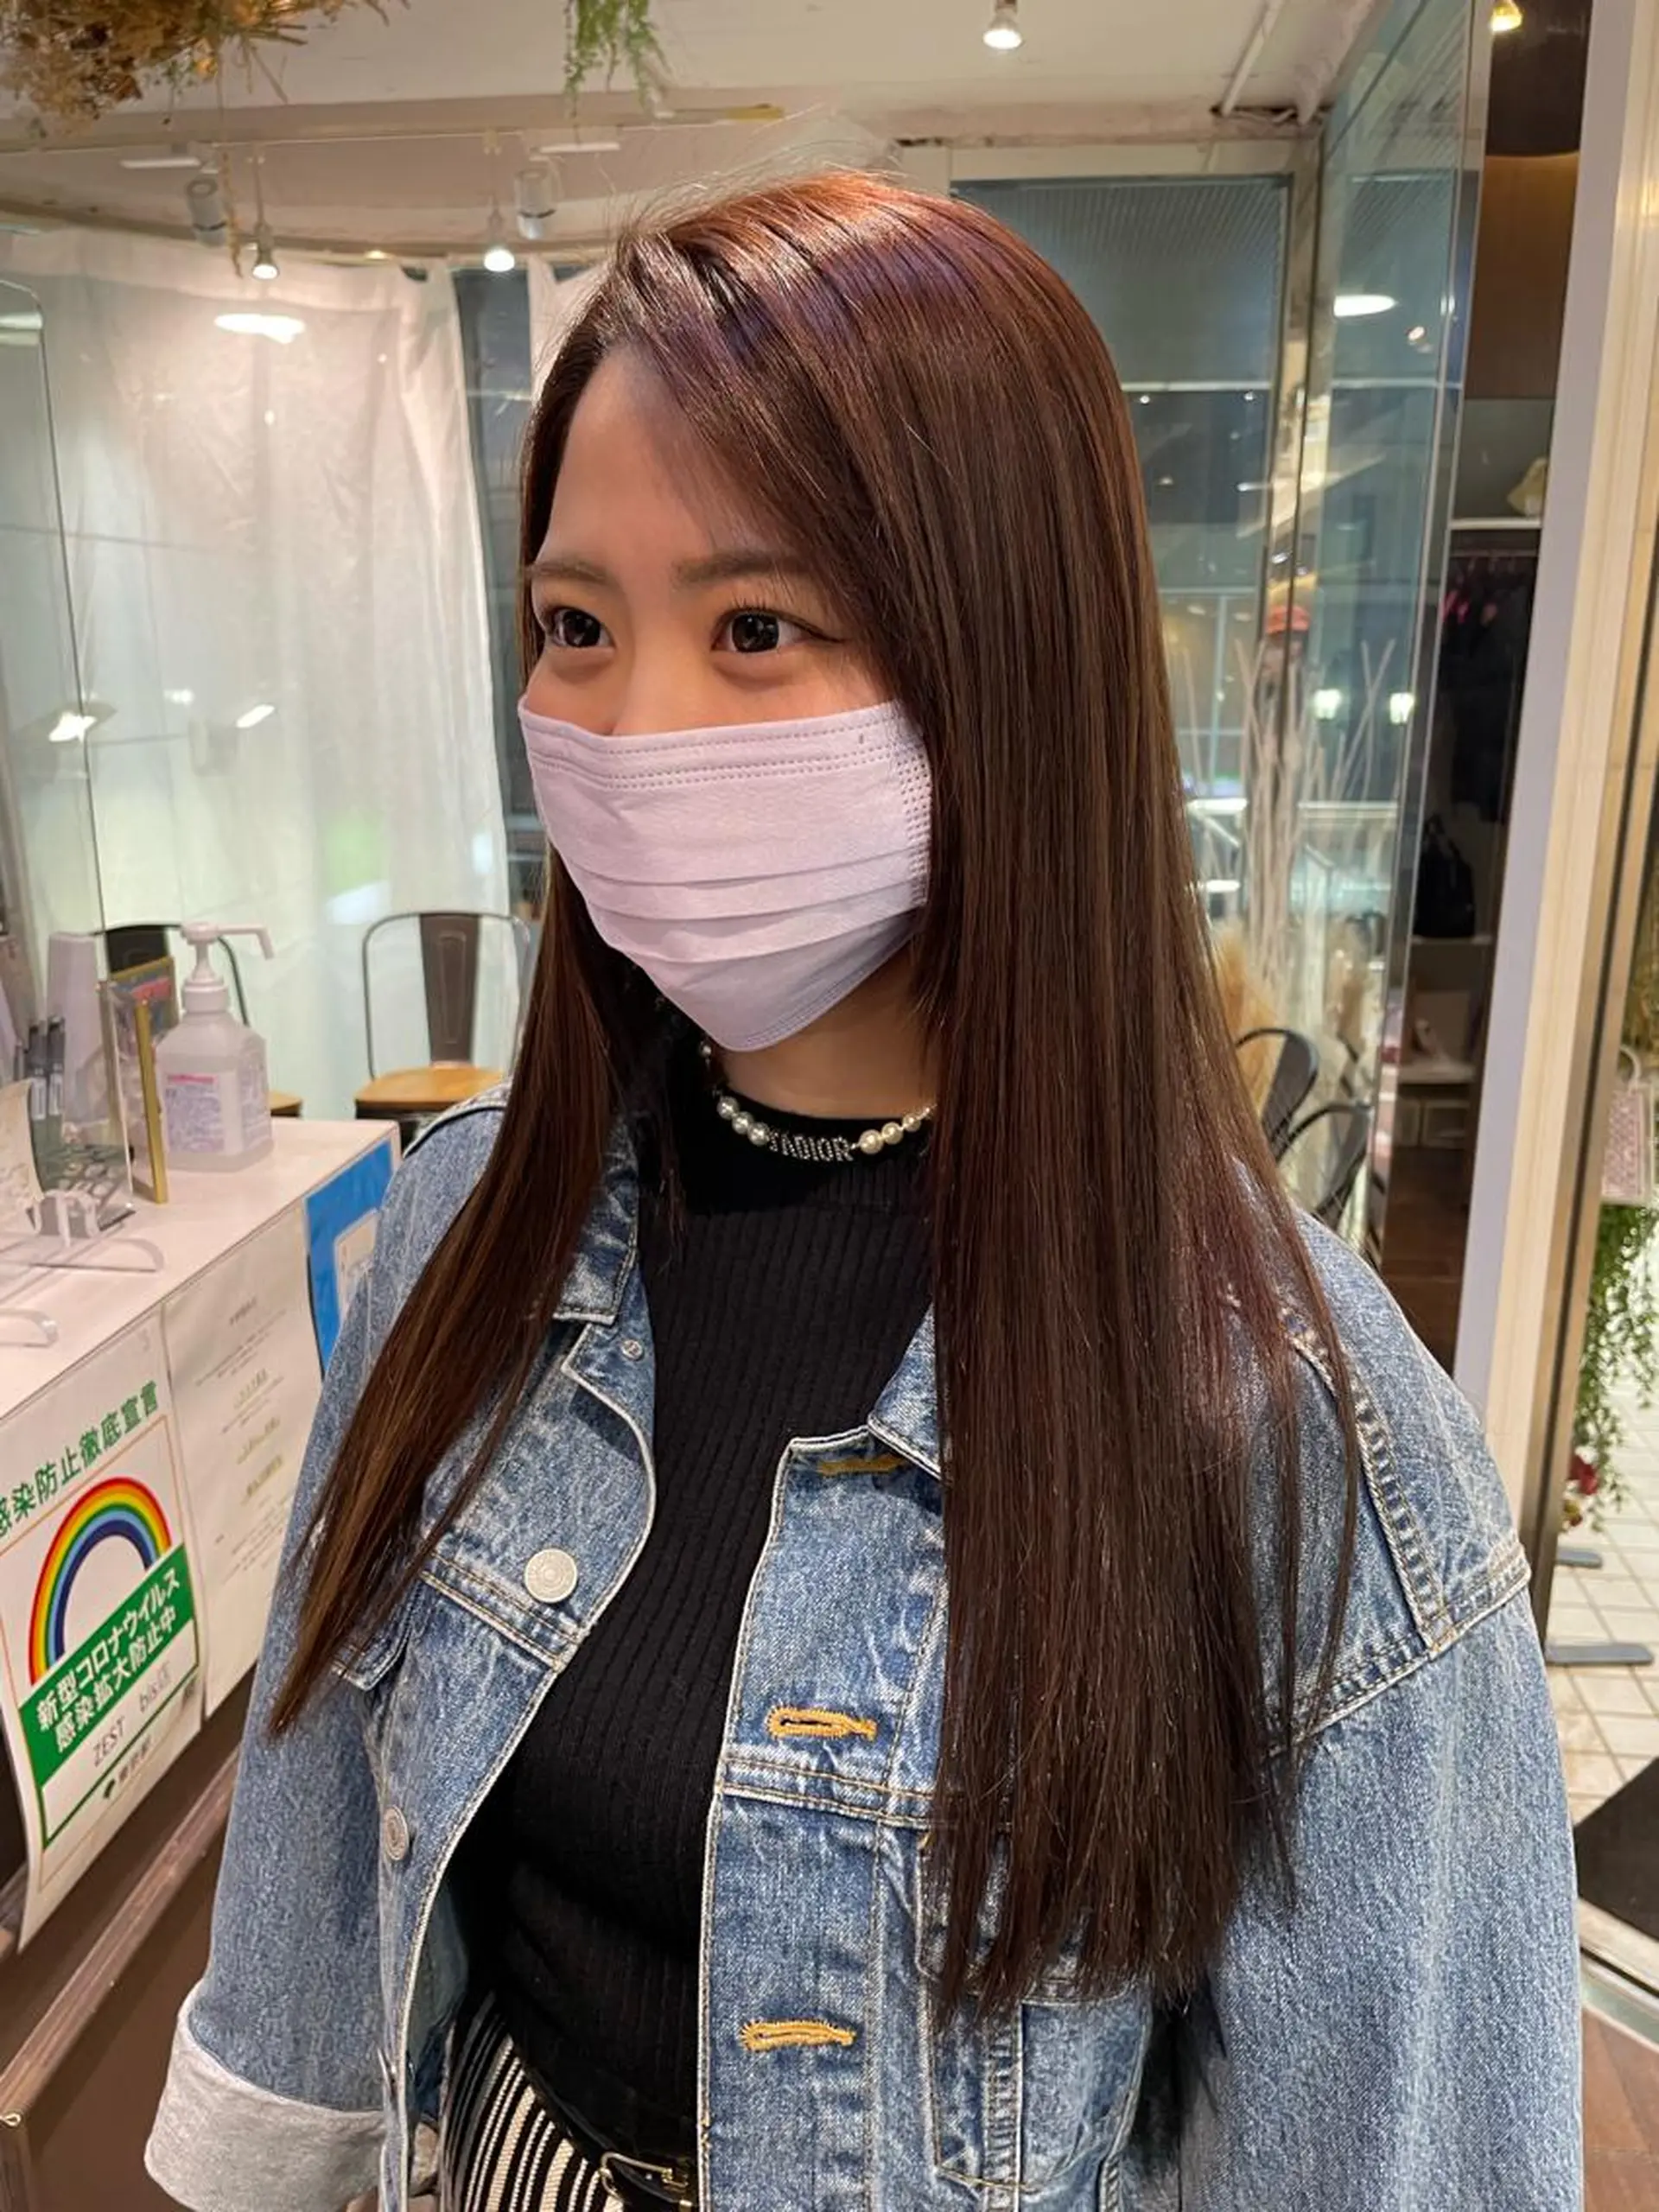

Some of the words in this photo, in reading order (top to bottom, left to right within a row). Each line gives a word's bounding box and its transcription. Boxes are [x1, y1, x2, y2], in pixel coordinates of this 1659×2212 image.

[36, 1567, 180, 1731] 新型コロナウイルス
[54, 1605, 176, 1752] 感染拡大防止中
[93, 1715, 124, 1767] ZEST
